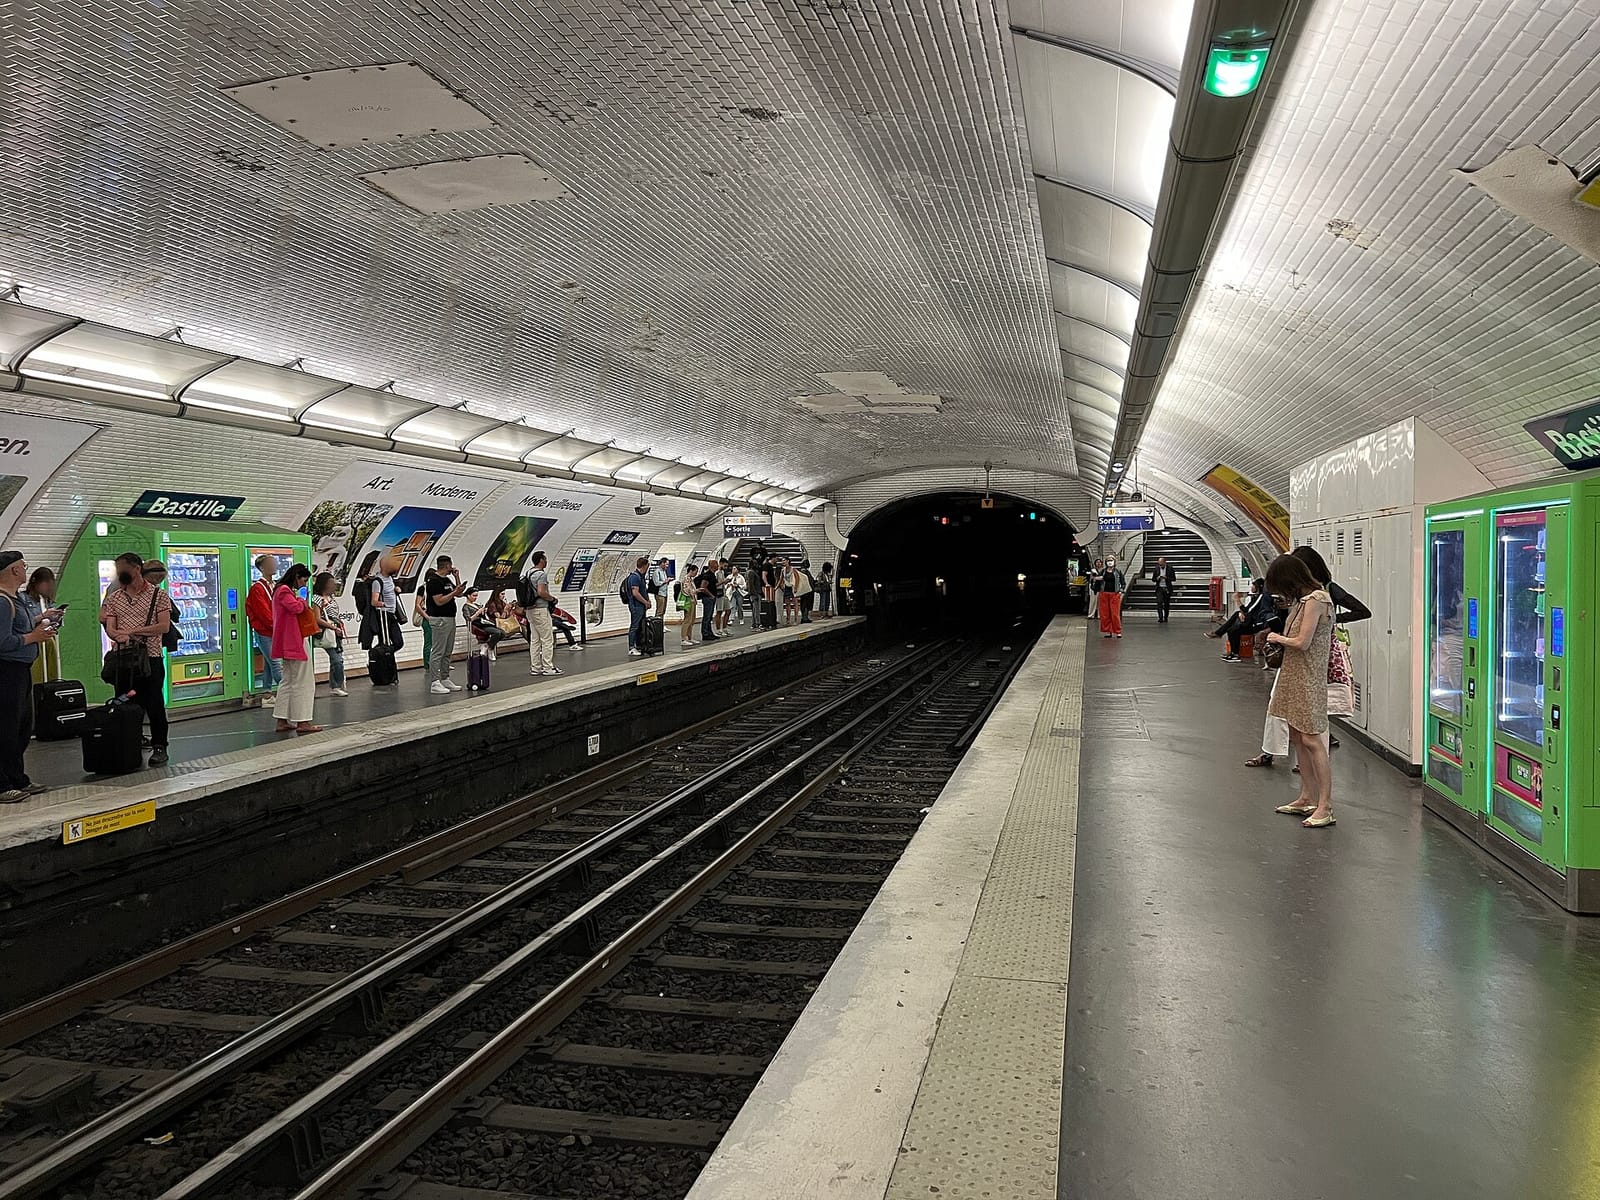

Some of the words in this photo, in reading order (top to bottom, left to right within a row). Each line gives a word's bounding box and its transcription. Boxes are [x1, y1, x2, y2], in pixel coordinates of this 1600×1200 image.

[1544, 416, 1600, 460] Bast
[421, 482, 477, 500] Moderne.
[147, 497, 226, 517] Bastille
[518, 495, 548, 507] Mode
[1099, 517, 1122, 525] Sortie
